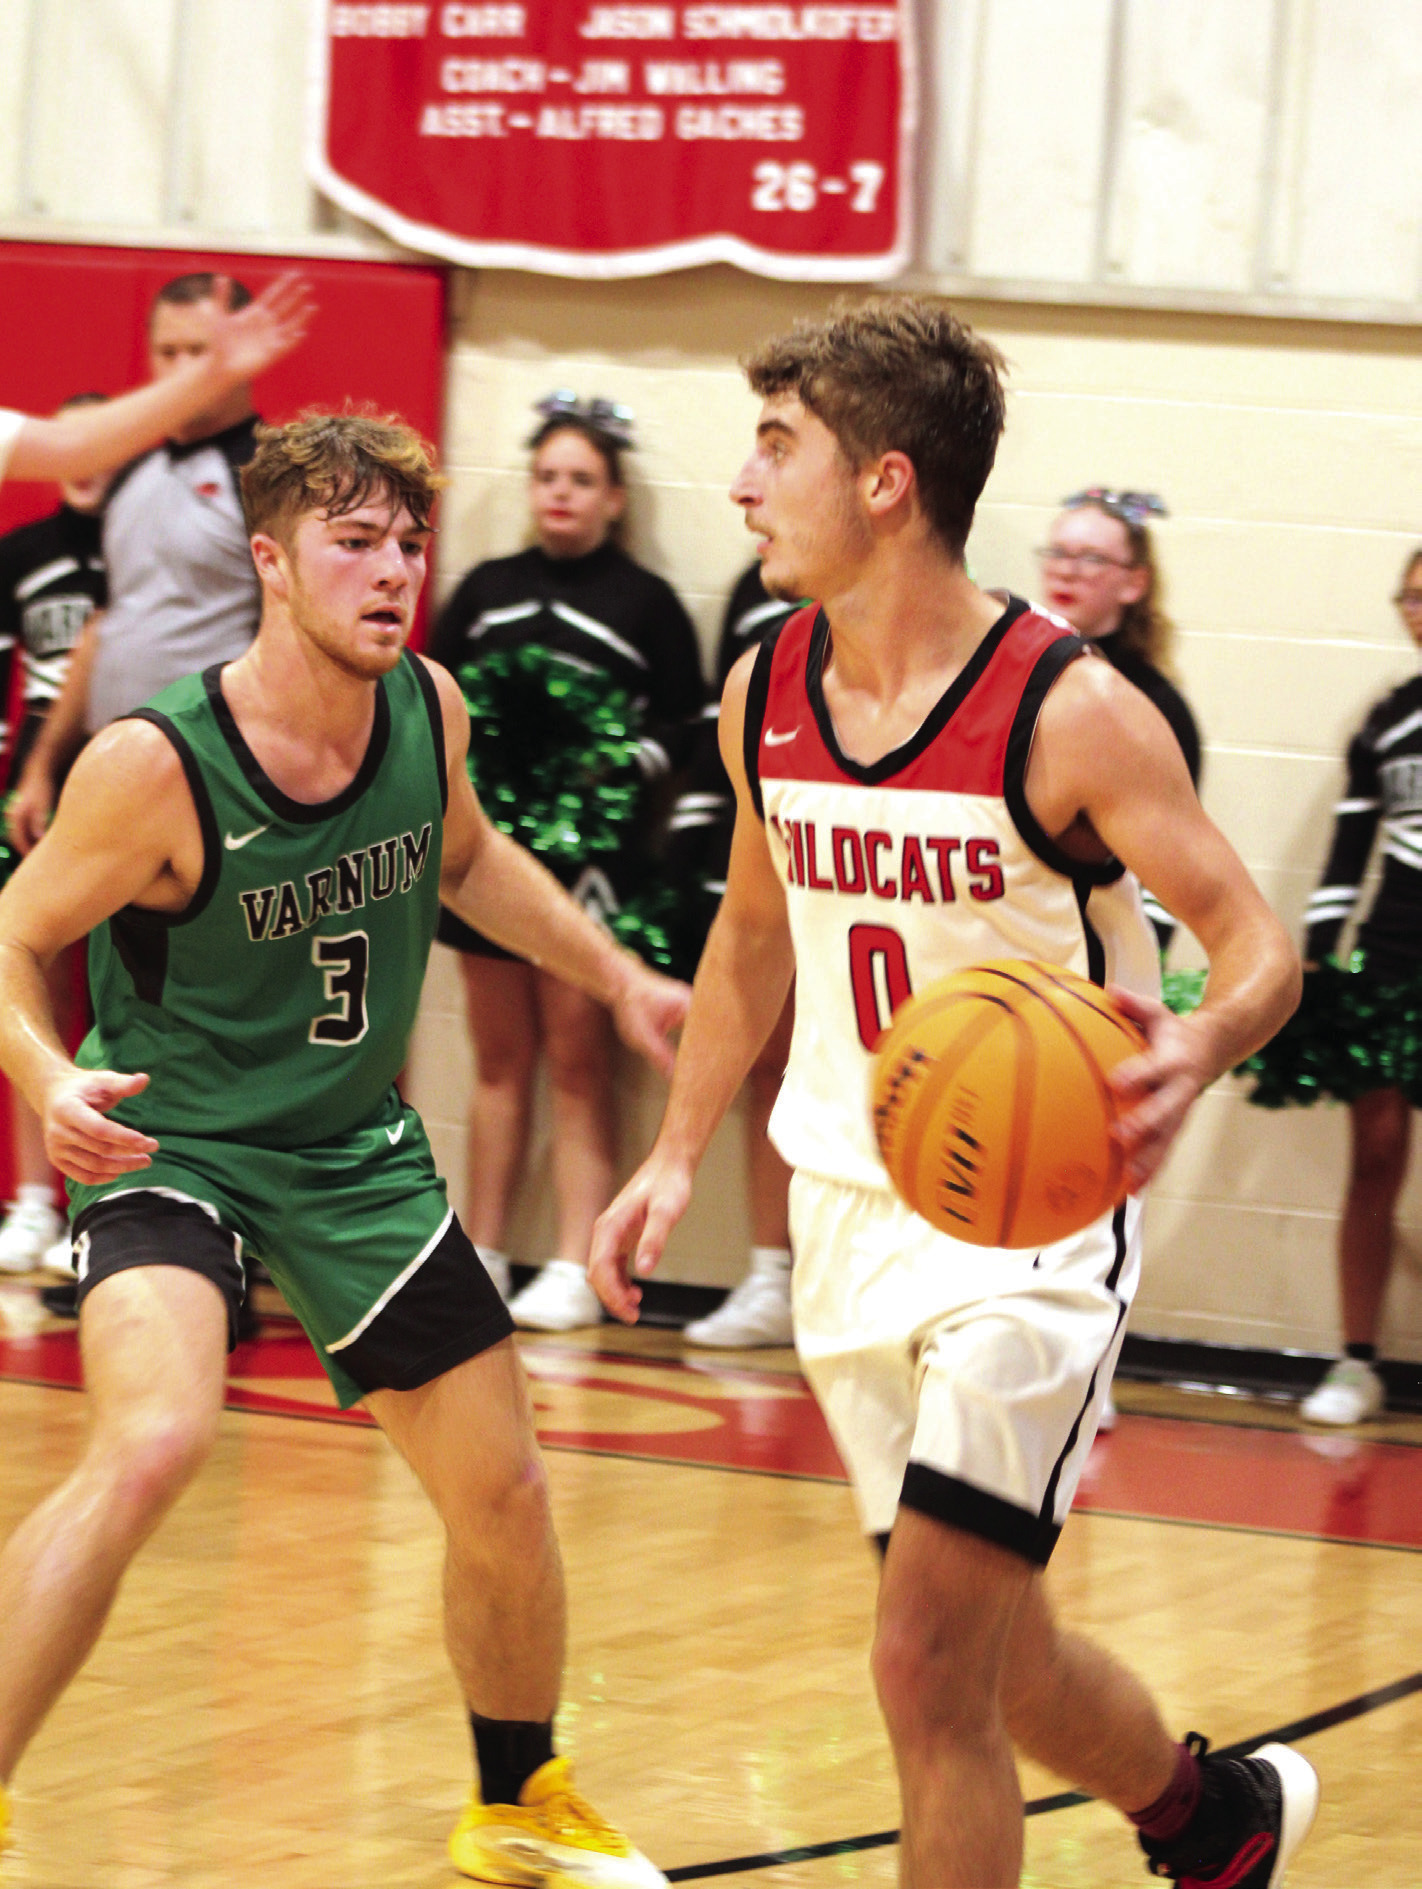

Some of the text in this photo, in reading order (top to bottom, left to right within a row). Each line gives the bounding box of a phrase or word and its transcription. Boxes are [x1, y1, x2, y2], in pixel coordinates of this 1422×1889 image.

[580, 6, 674, 40] JASON
[239, 821, 432, 941] VARNUM
[308, 929, 369, 1047] 3
